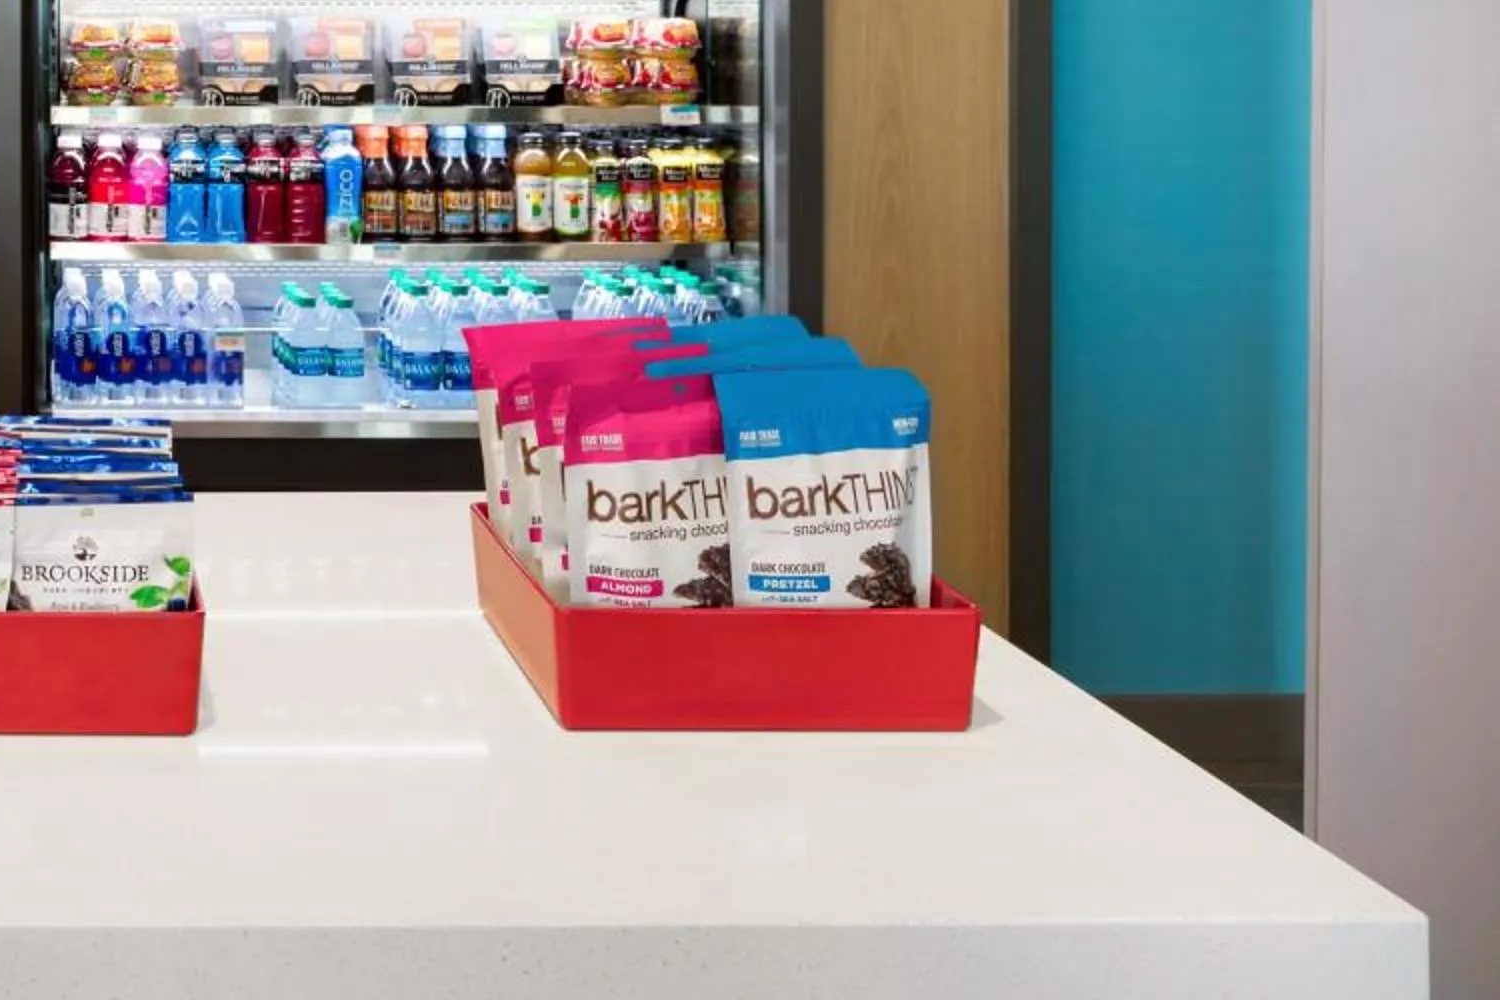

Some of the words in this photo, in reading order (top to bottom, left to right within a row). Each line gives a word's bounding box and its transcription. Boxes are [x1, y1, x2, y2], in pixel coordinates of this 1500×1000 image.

[630, 527, 687, 541] snacking
[793, 520, 851, 536] snacking
[21, 564, 149, 585] BROOKSIDE
[601, 581, 653, 595] ALMOND
[763, 579, 819, 589] PRETZEL
